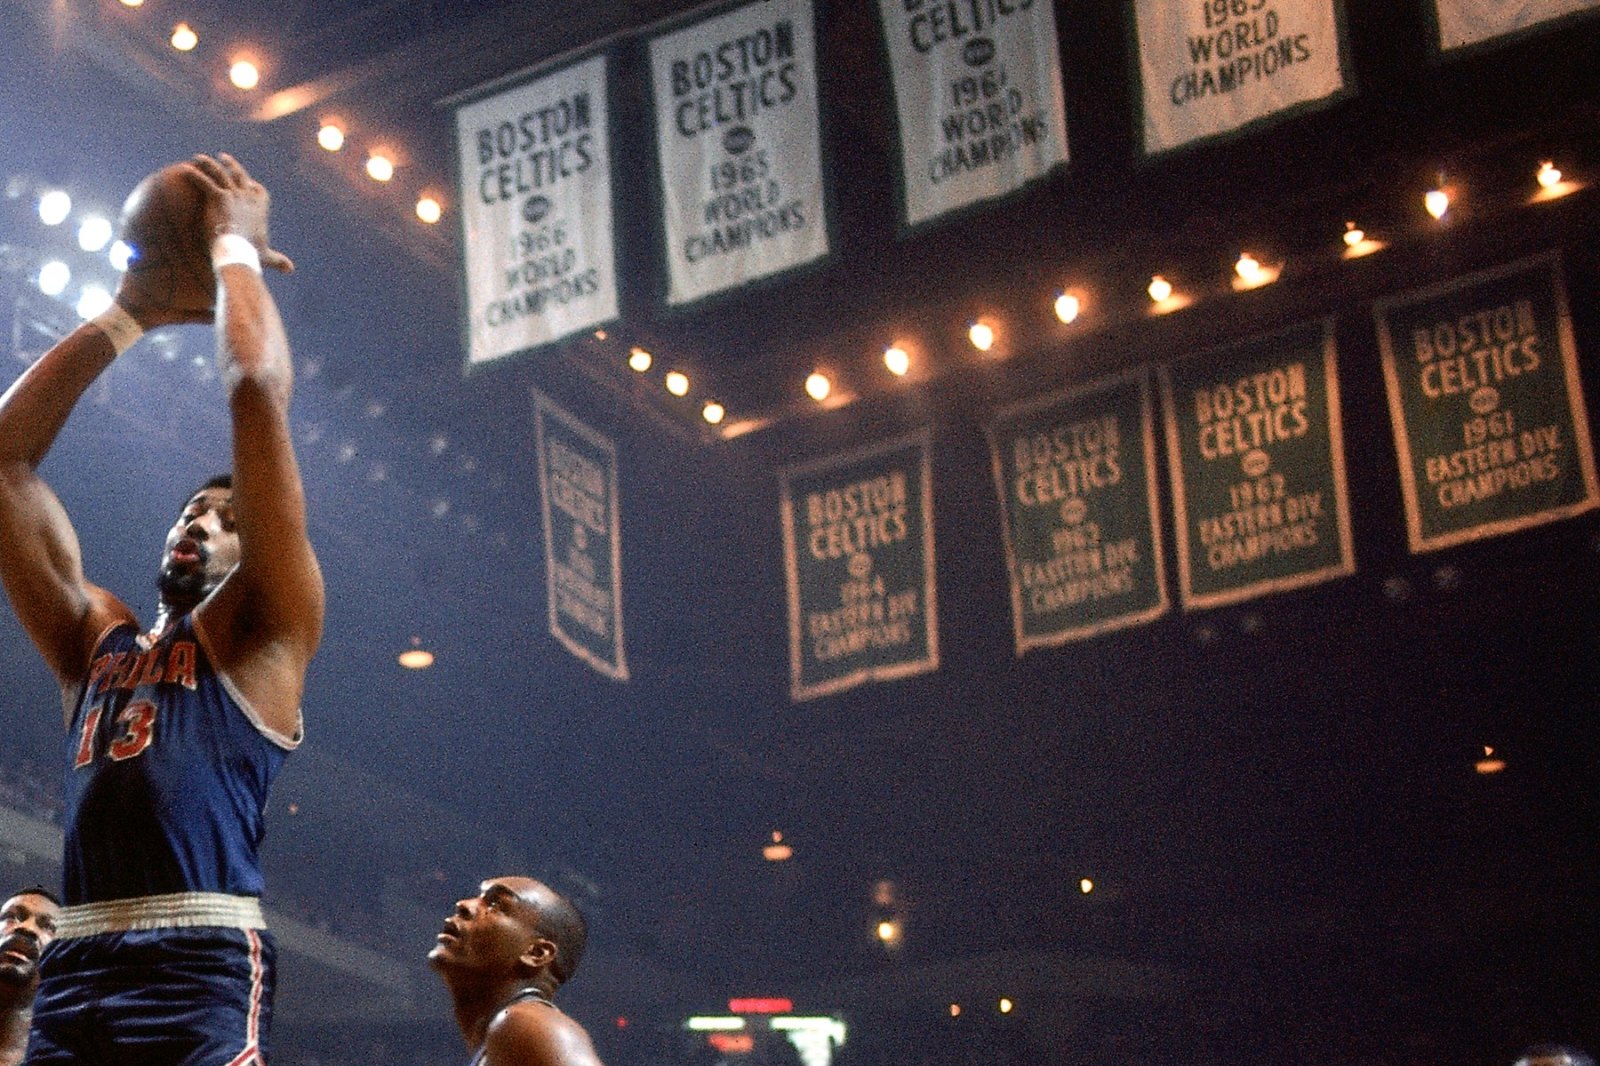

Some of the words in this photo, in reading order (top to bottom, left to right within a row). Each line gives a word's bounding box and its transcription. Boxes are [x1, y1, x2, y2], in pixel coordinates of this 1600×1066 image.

[908, 0, 1033, 53] CELTI
[1187, 9, 1279, 63] WORLD
[670, 20, 795, 97] BOSTON
[1170, 33, 1311, 106] CHAMPIONS
[477, 92, 591, 164] BOSTON
[676, 64, 797, 138] CELTICS
[479, 134, 593, 205] CELTICS
[685, 200, 806, 263] CHAMPIONS
[703, 180, 782, 224] WORLD
[486, 267, 600, 328] CHAMPIONS
[1414, 300, 1537, 362] BOSTON
[1196, 362, 1305, 424] BOSTON
[1421, 336, 1541, 398] CELTICS
[1015, 417, 1120, 472] BOSTON
[1200, 400, 1309, 461] CELTICS
[1464, 410, 1515, 445] 1961
[808, 470, 907, 526] BOSTON
[1017, 448, 1122, 506] CELTICS
[1438, 453, 1560, 508] CHAMPIONS
[810, 507, 908, 560] CELTICS
[87, 641, 198, 692] PHILA
[74, 701, 158, 769] 13
